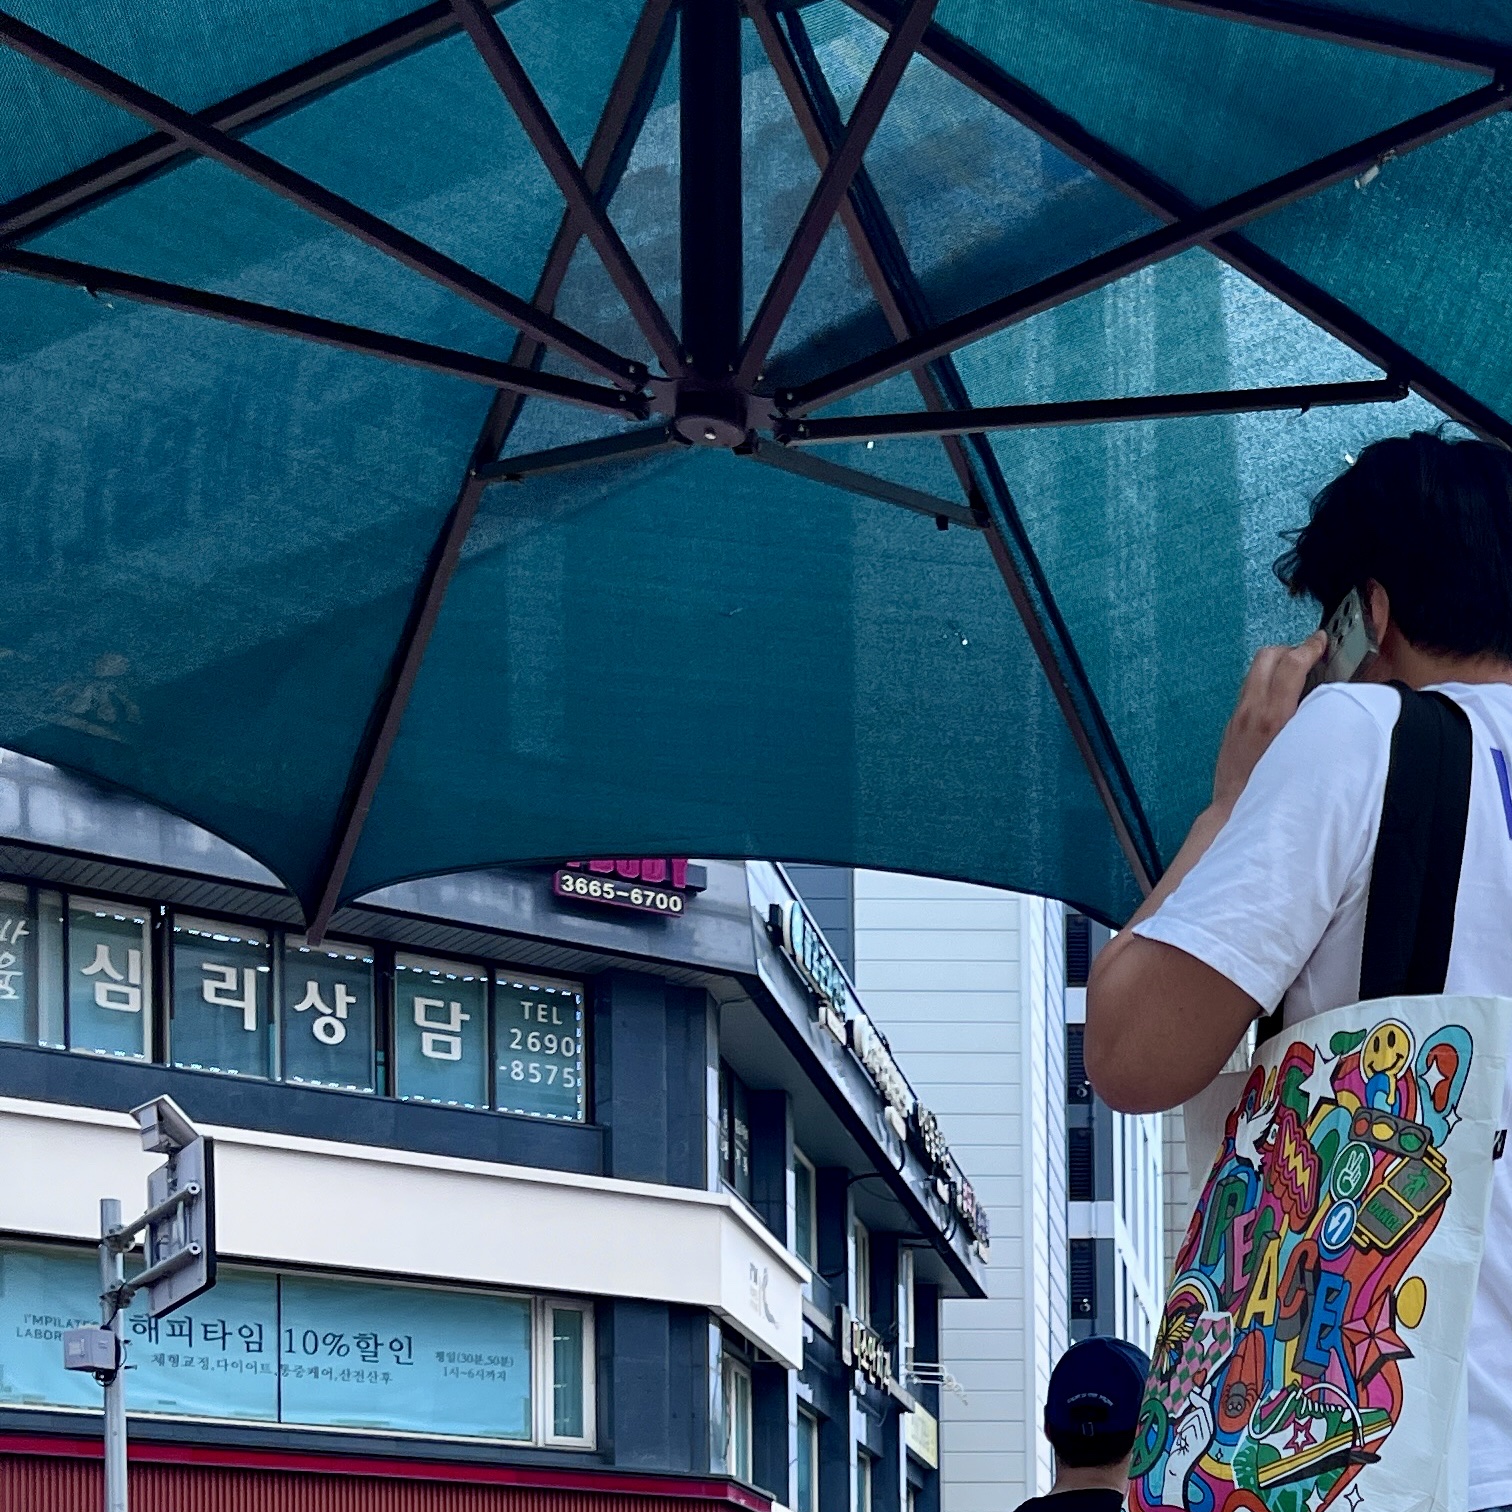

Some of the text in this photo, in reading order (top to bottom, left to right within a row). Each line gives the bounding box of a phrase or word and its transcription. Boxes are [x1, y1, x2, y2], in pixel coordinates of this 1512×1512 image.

[561, 875, 682, 912] 3665-6700
[520, 1001, 563, 1025] TEL
[509, 1028, 575, 1058] 2690
[1202, 1177, 1344, 1370] PEACE
[130, 1314, 263, 1353] 해피타임
